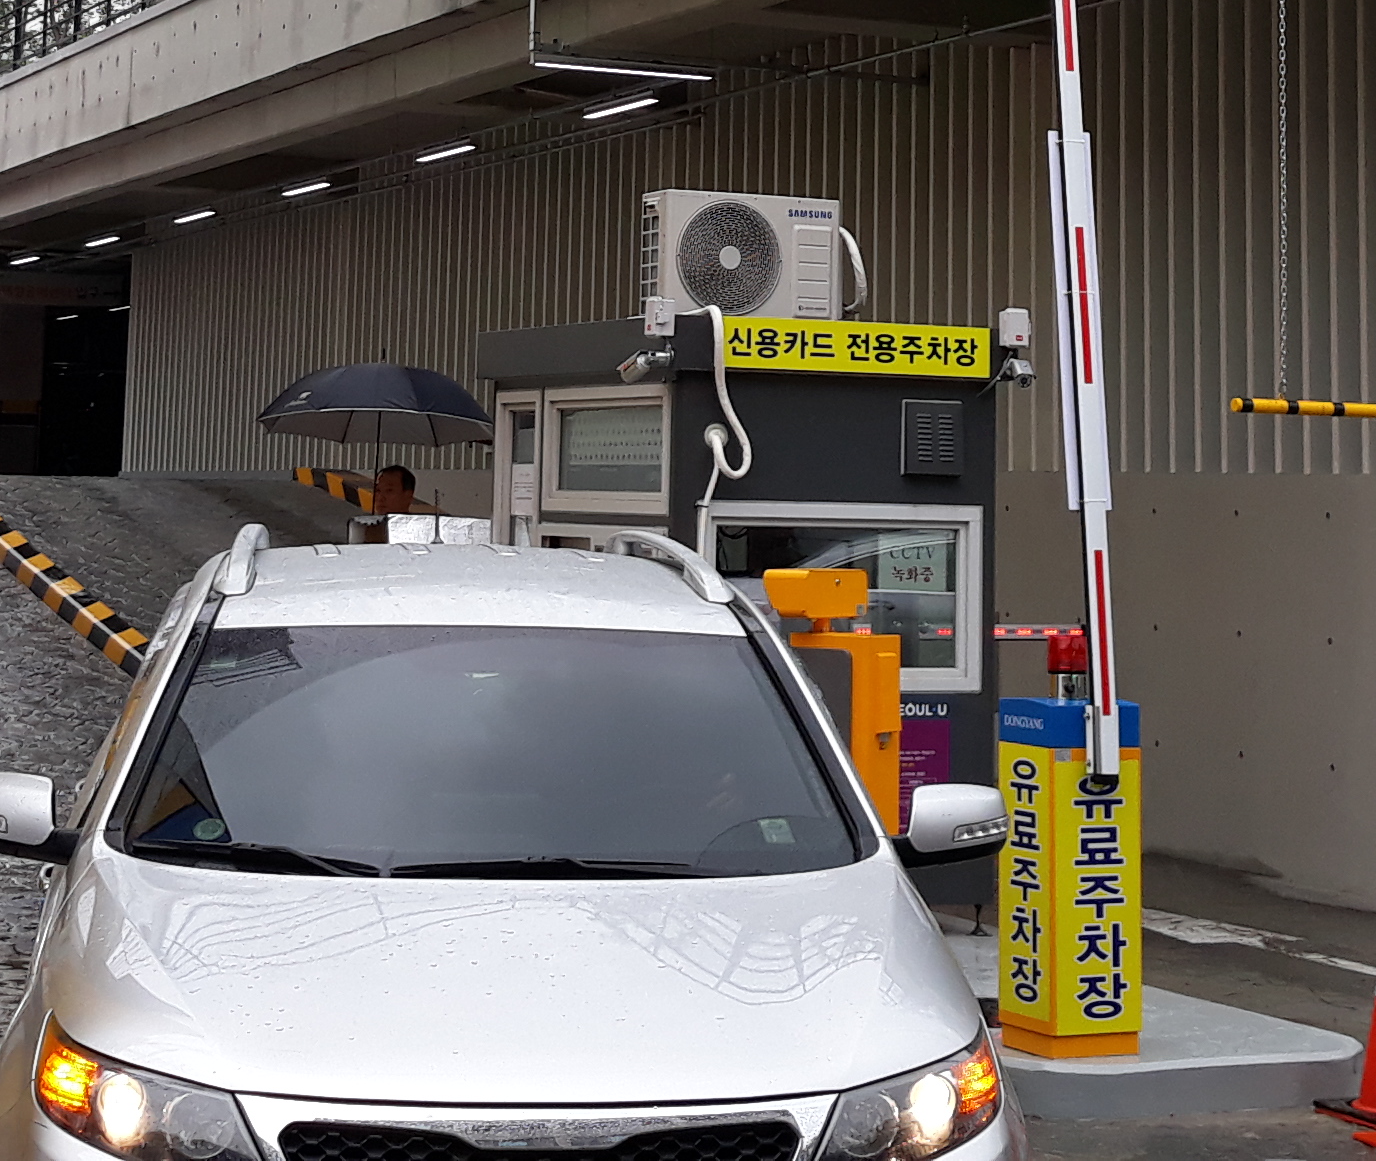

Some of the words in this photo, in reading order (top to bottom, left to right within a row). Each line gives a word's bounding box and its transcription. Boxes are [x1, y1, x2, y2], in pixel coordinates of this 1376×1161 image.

[788, 208, 833, 220] SAMSUNG
[727, 327, 836, 360] 신용카드
[846, 332, 978, 367] 전용주차장
[891, 566, 934, 583] 녹화중
[1003, 714, 1044, 730] DONGYANG
[1010, 758, 1042, 1004] 유료주차장
[1073, 775, 1128, 1019] 유료주차장
